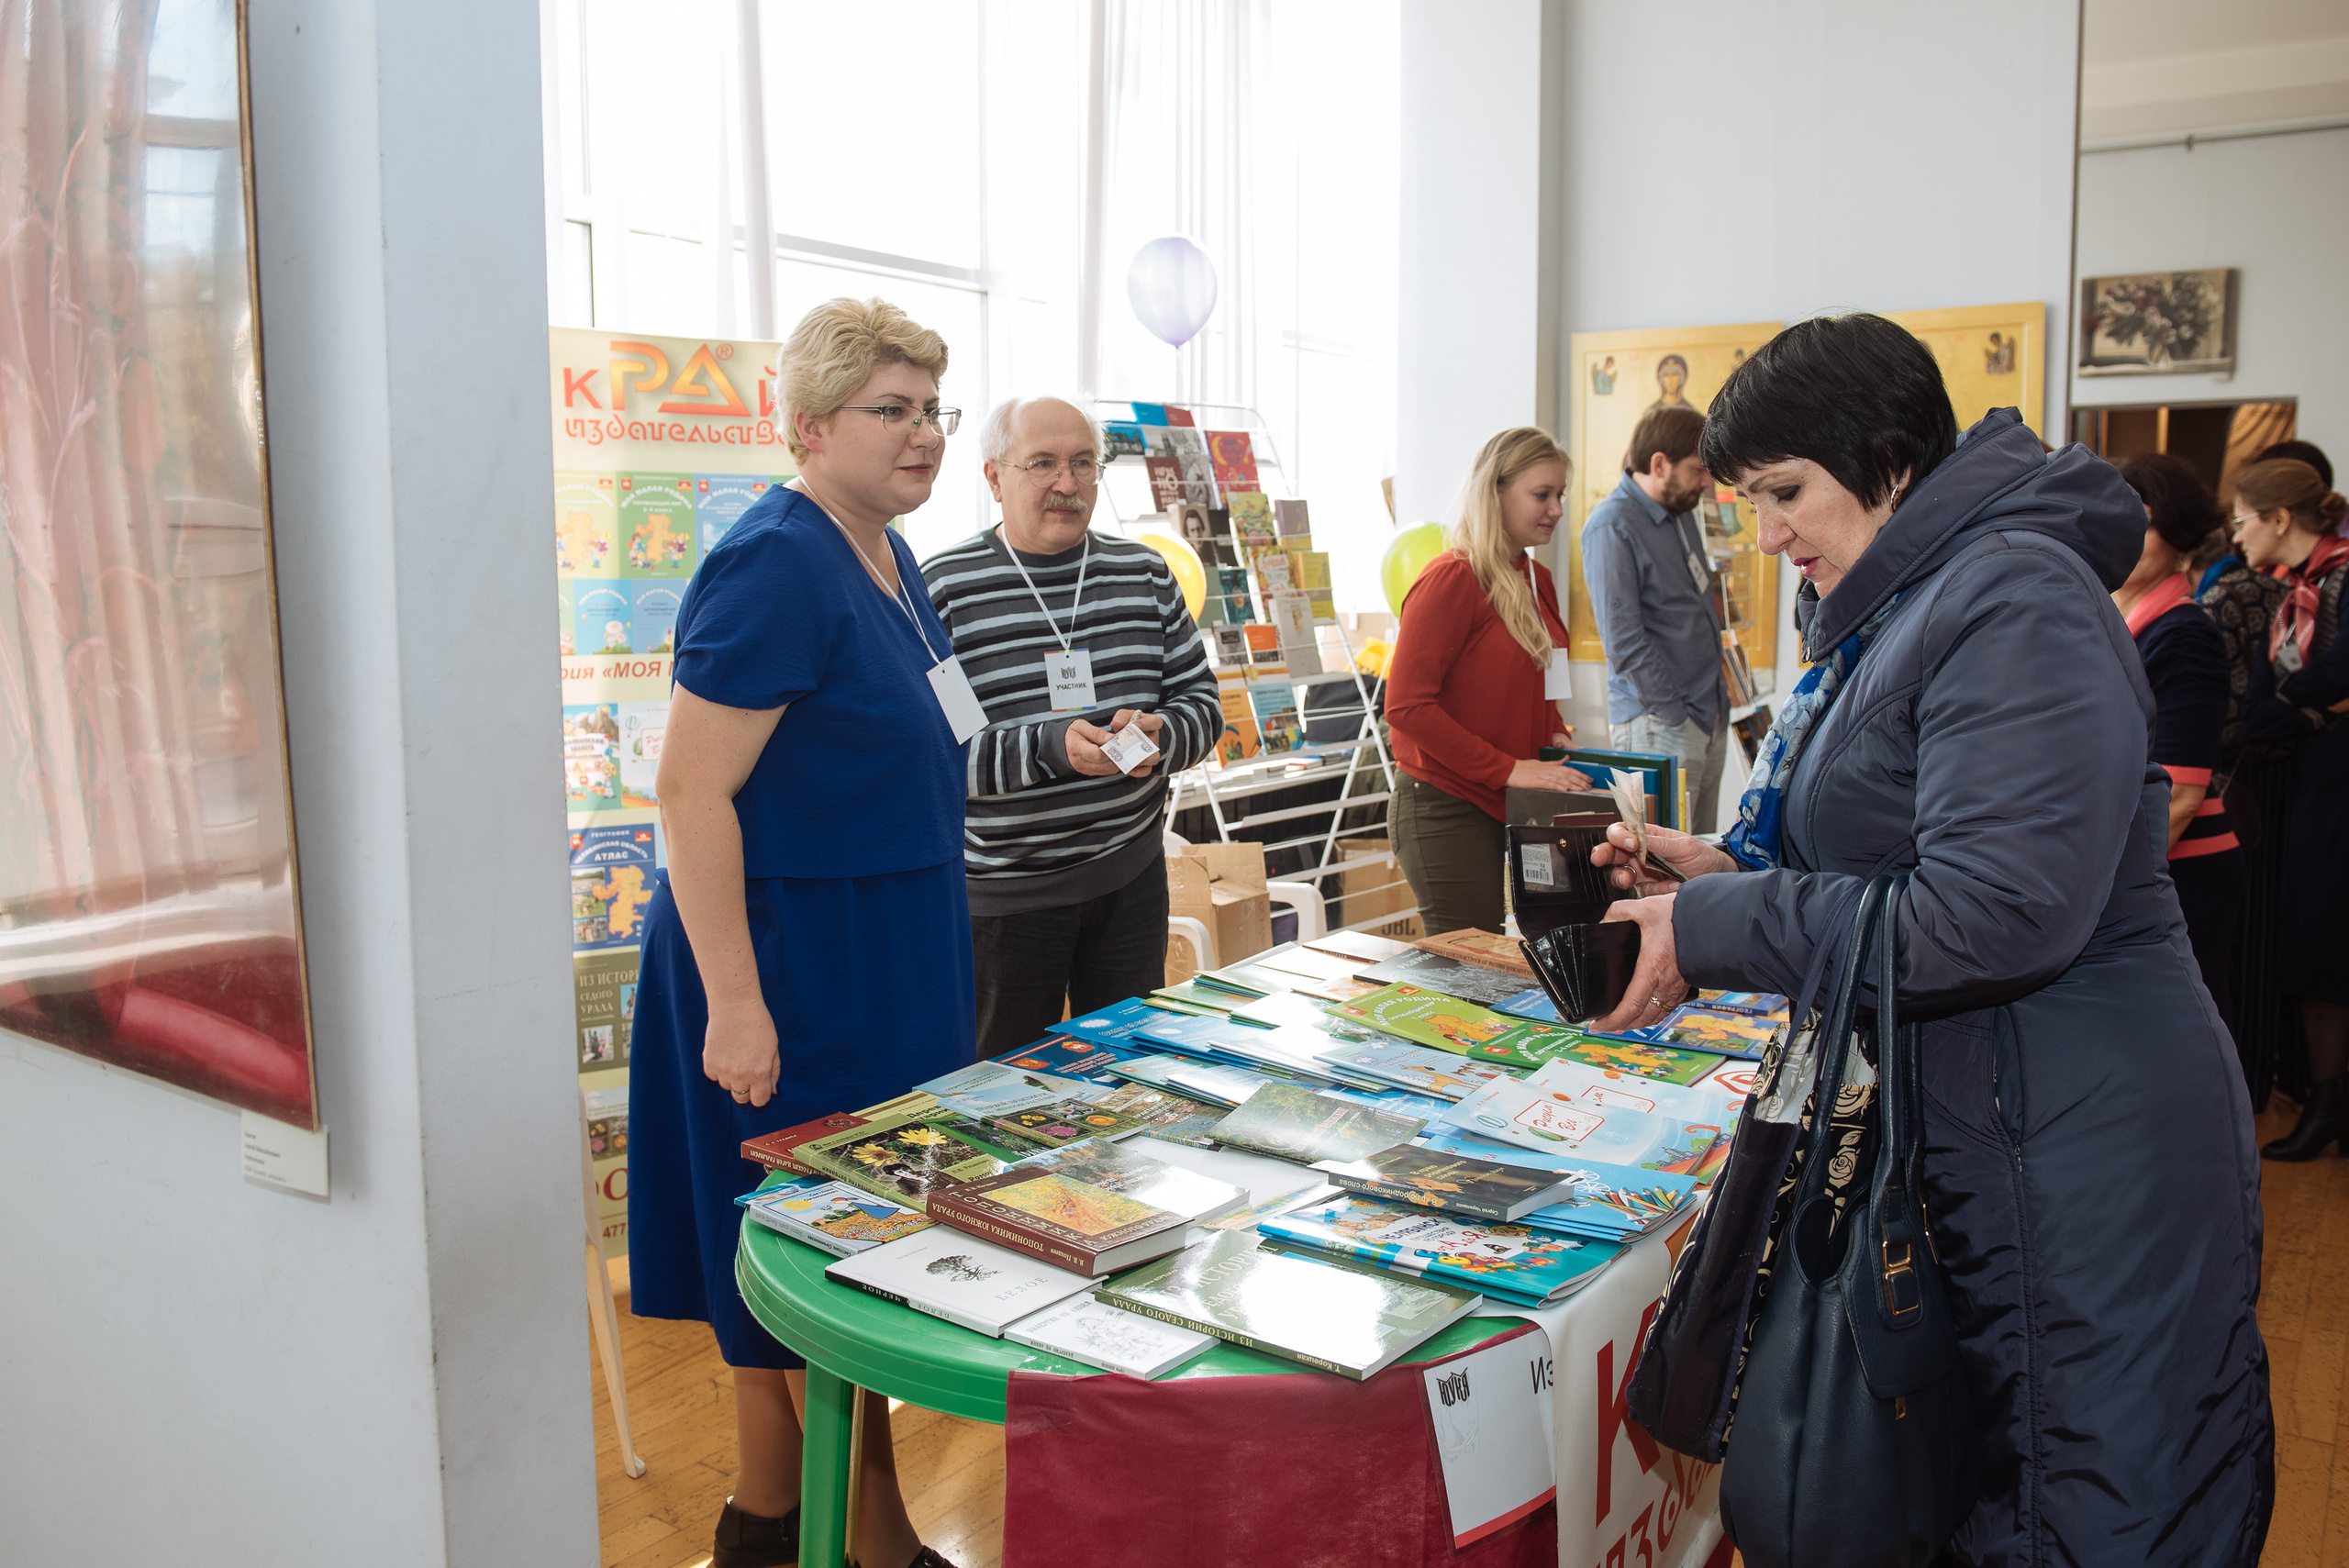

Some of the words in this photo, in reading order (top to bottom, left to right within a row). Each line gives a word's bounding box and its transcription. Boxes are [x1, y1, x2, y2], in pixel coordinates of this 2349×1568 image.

[565, 414, 785, 445] издательств
[1056, 682, 1087, 691] УЧАСТНИК
[594, 851, 629, 862] АТЛАС
[1382, 918, 1416, 936] JBL
[579, 974, 595, 987] ИЗ
[580, 990, 614, 1001] СЕДОГО
[581, 1002, 613, 1015] УРАЛА
[1712, 1004, 1753, 1014] ГЕОГРАФИЯ
[906, 1105, 941, 1119] Дерев
[1339, 1178, 1361, 1188] слова
[1362, 1183, 1409, 1199] родникового
[1410, 1192, 1431, 1203] краю
[931, 1203, 955, 1218] УРАЛА
[1456, 1203, 1482, 1212] Черепанов
[1482, 1207, 1499, 1216] Сергей
[955, 1211, 990, 1231] ЮЖНОГО
[990, 1223, 1044, 1251] ТОПОНИМИКА
[1100, 1223, 1143, 1240] ЮЖНОГО
[1050, 1249, 1072, 1262] Поздеев
[996, 1276, 1048, 1301] БЕЛОЕ
[862, 1284, 901, 1303] ЧЕРНОЕ
[917, 1304, 951, 1319] БЕЛОЕ
[1112, 1298, 1142, 1314] УРАЛА
[1147, 1308, 1184, 1327] СЕДОГО
[1187, 1321, 1235, 1341] ИСТОРИИ
[1240, 1337, 1253, 1348] ИЗ
[1297, 1353, 1332, 1370] Корецкая
[1333, 1364, 1341, 1373] Т.
